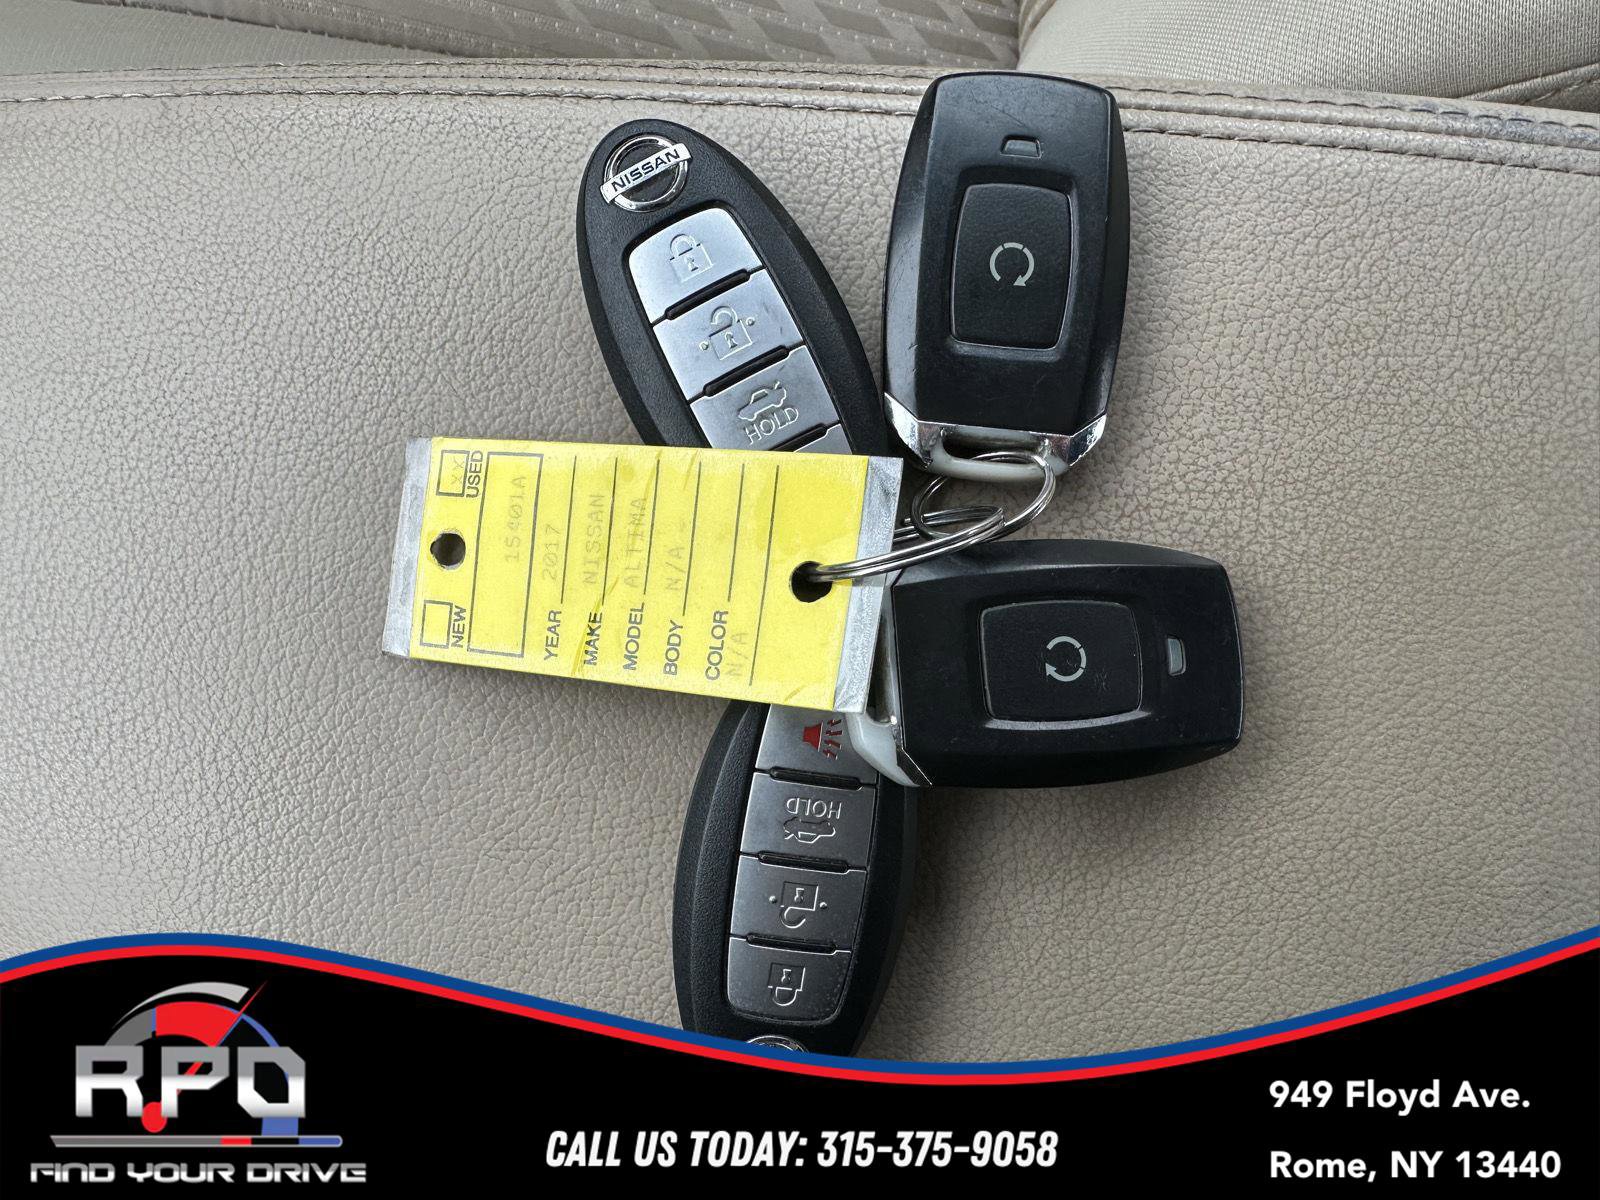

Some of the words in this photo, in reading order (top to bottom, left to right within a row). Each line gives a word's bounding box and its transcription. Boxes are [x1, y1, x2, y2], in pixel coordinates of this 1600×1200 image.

[610, 147, 682, 193] NISSAN
[743, 406, 799, 445] HOLD
[465, 450, 484, 498] USED
[542, 523, 561, 582] 2017
[583, 494, 605, 584] NISSAN
[623, 496, 648, 588] ALTIMA
[665, 545, 686, 591] N/A
[450, 605, 467, 649] NEW
[543, 609, 563, 661] YEAR
[583, 611, 603, 666] MAKE
[622, 602, 645, 671] MODEL
[663, 619, 684, 676] BODY
[705, 610, 729, 680] COLOR
[786, 797, 842, 819] HOLD
